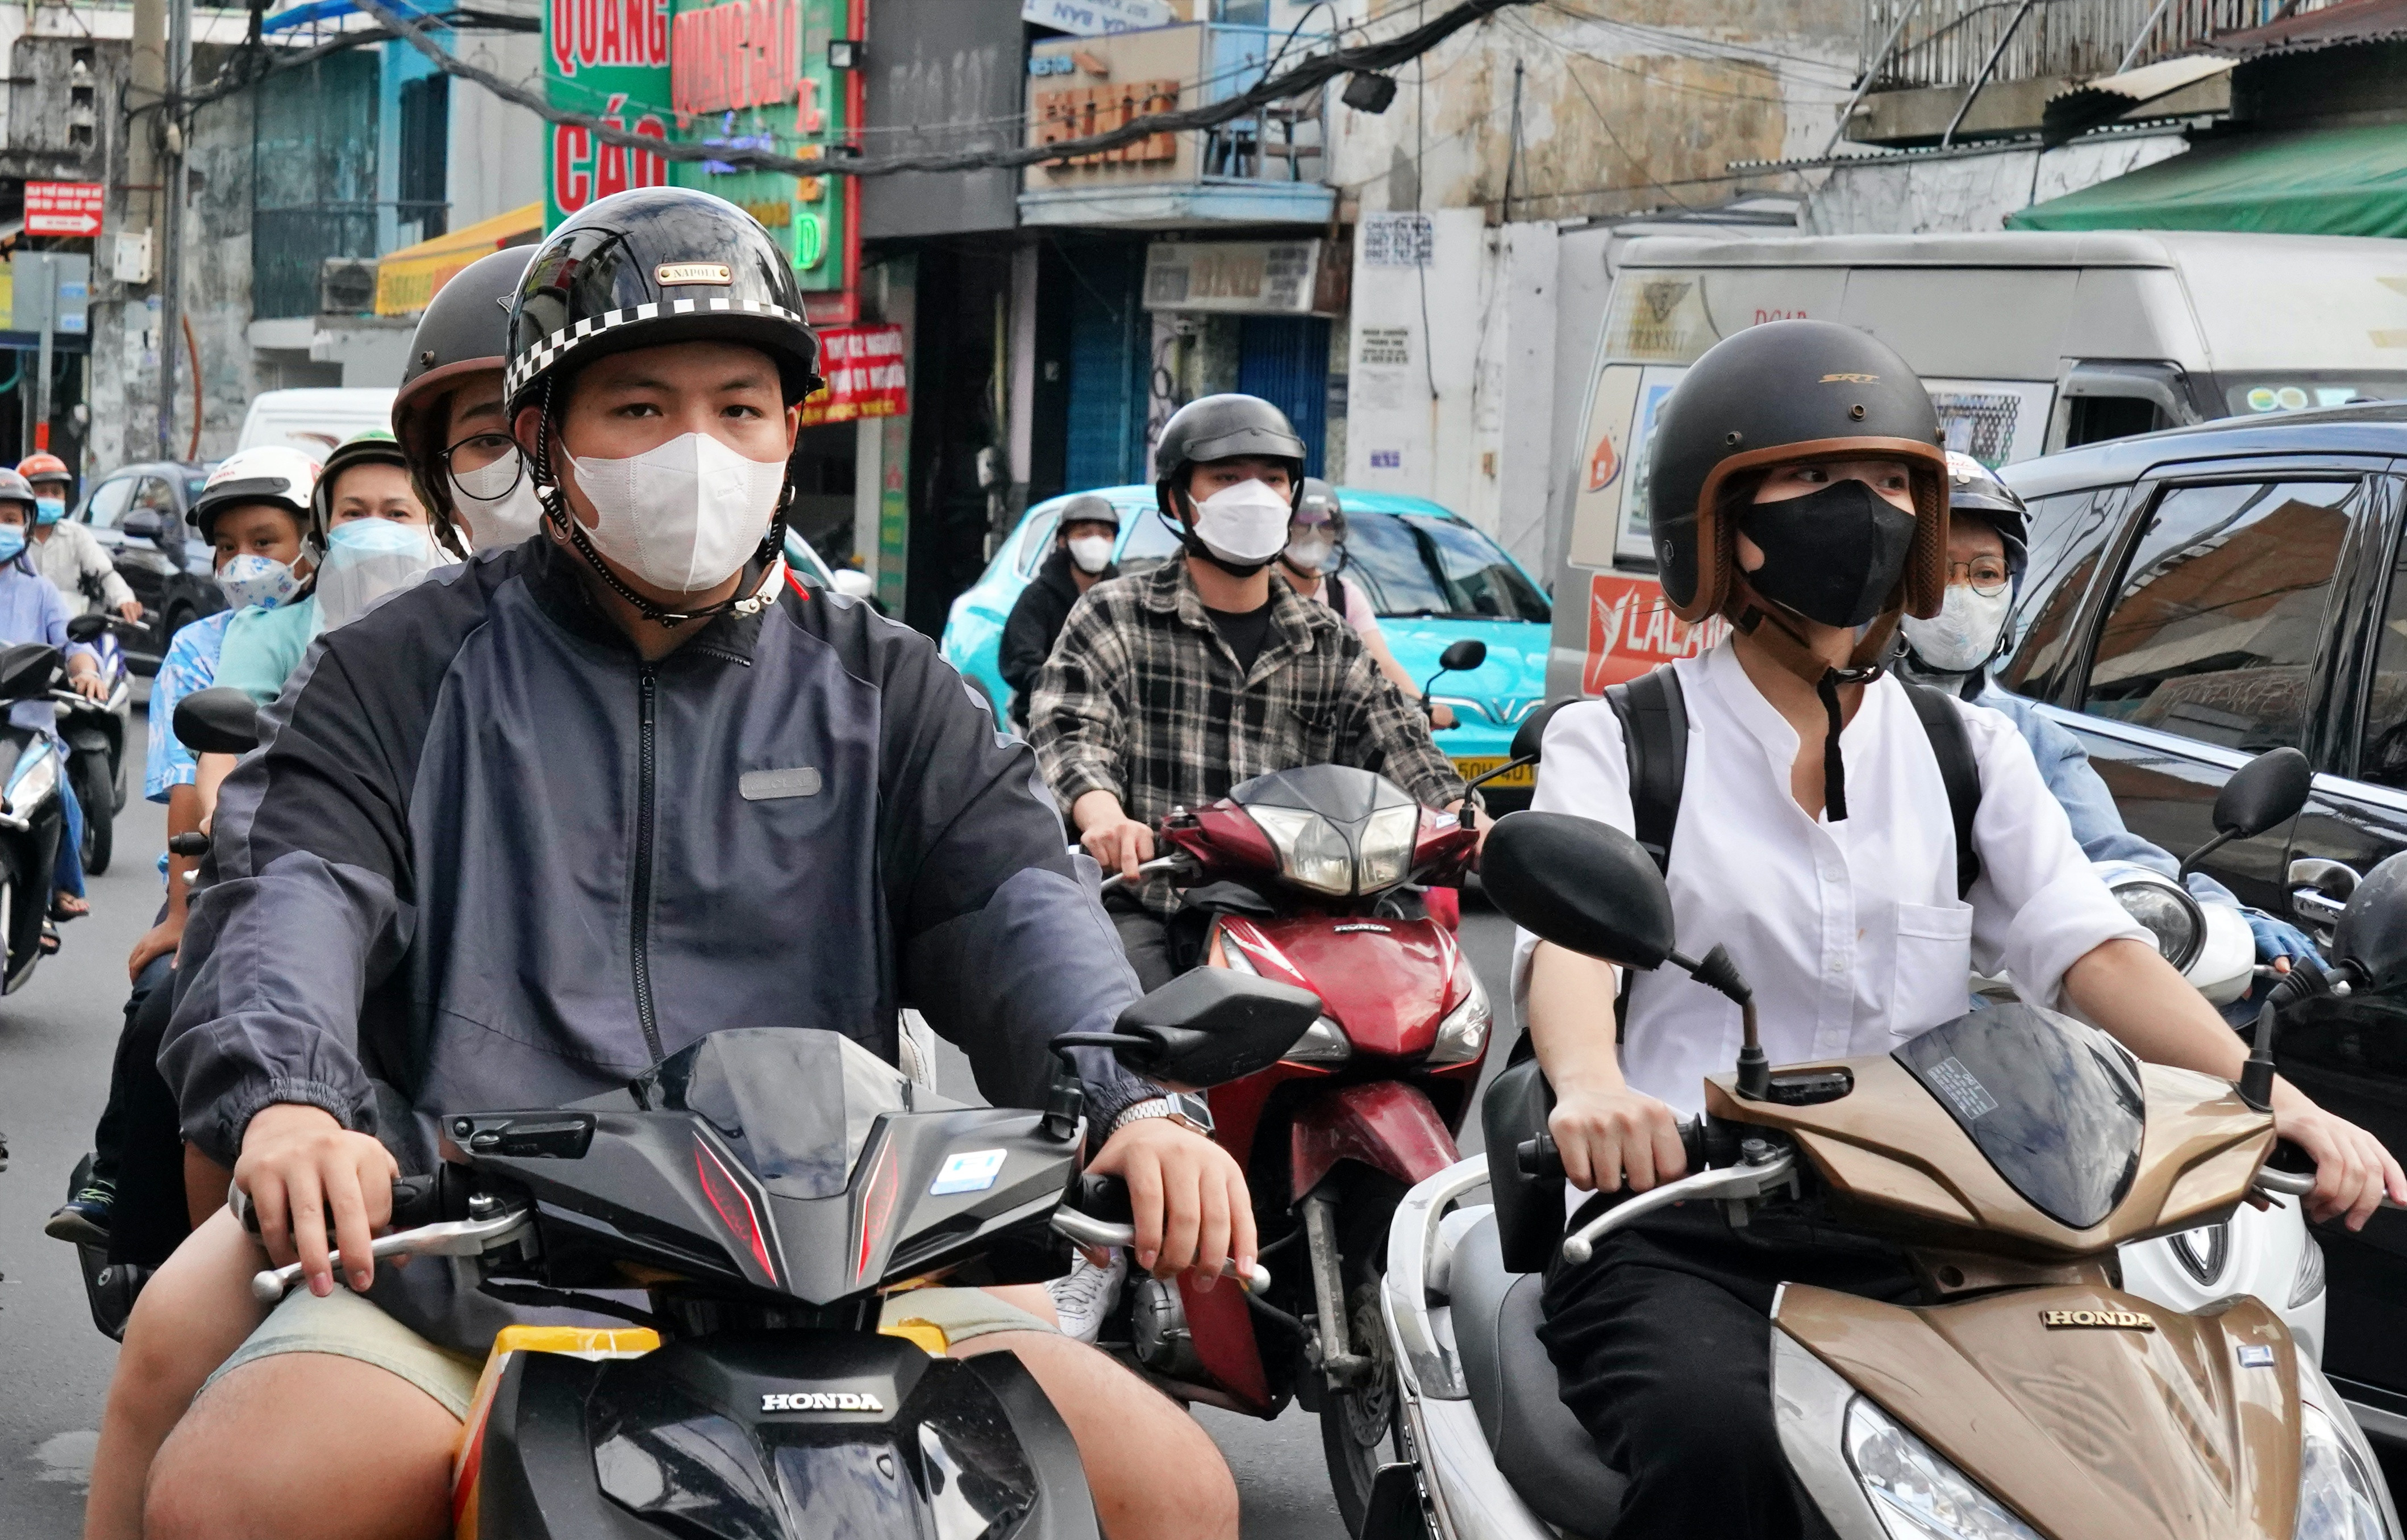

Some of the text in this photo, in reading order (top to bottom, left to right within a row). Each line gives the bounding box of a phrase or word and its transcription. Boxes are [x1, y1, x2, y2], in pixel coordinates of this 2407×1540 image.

[673, 269, 716, 278] NAPOLI
[1626, 592, 1734, 657] LALAM
[1333, 923, 1392, 932] HONDA
[2047, 1311, 2152, 1326] HONDA
[761, 1393, 884, 1411] HONDA
